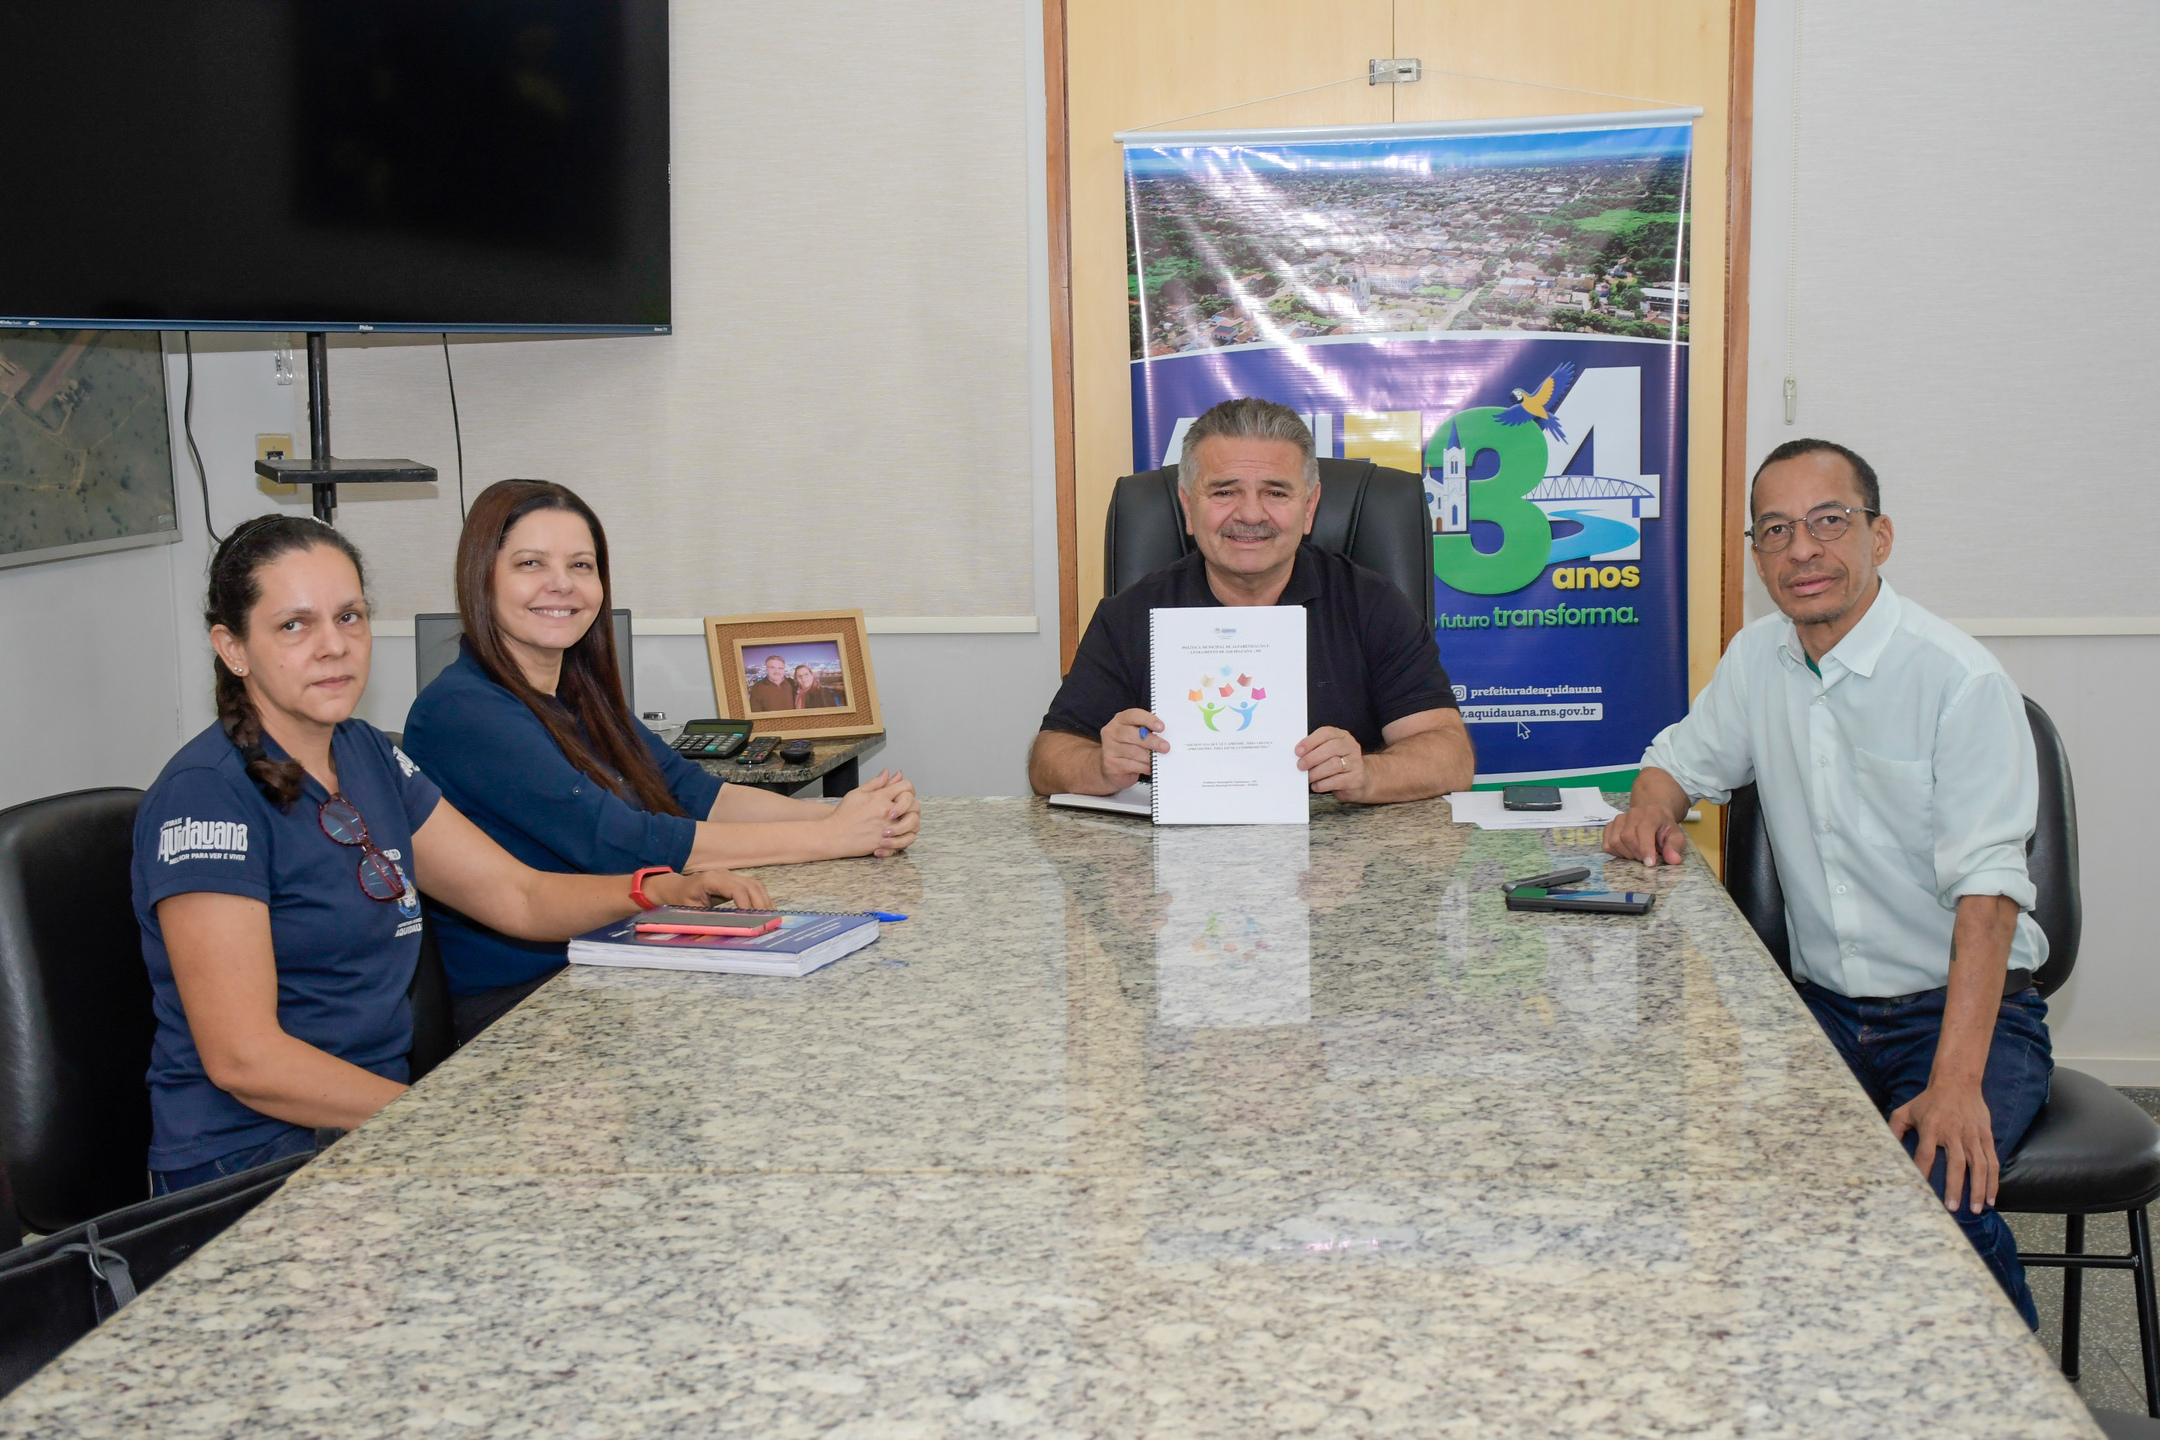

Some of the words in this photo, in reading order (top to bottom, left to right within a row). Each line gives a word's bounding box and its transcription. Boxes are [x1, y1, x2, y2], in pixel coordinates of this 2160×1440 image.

[1552, 565, 1640, 590] anos
[1440, 613, 1491, 628] futuro
[1493, 603, 1640, 627] transforma.
[1471, 685, 1603, 698] prefeituradeaquidauana
[169, 853, 190, 865] MELHOR
[191, 852, 209, 860] PARA
[209, 852, 222, 860] VER
[229, 853, 246, 862] VIVER
